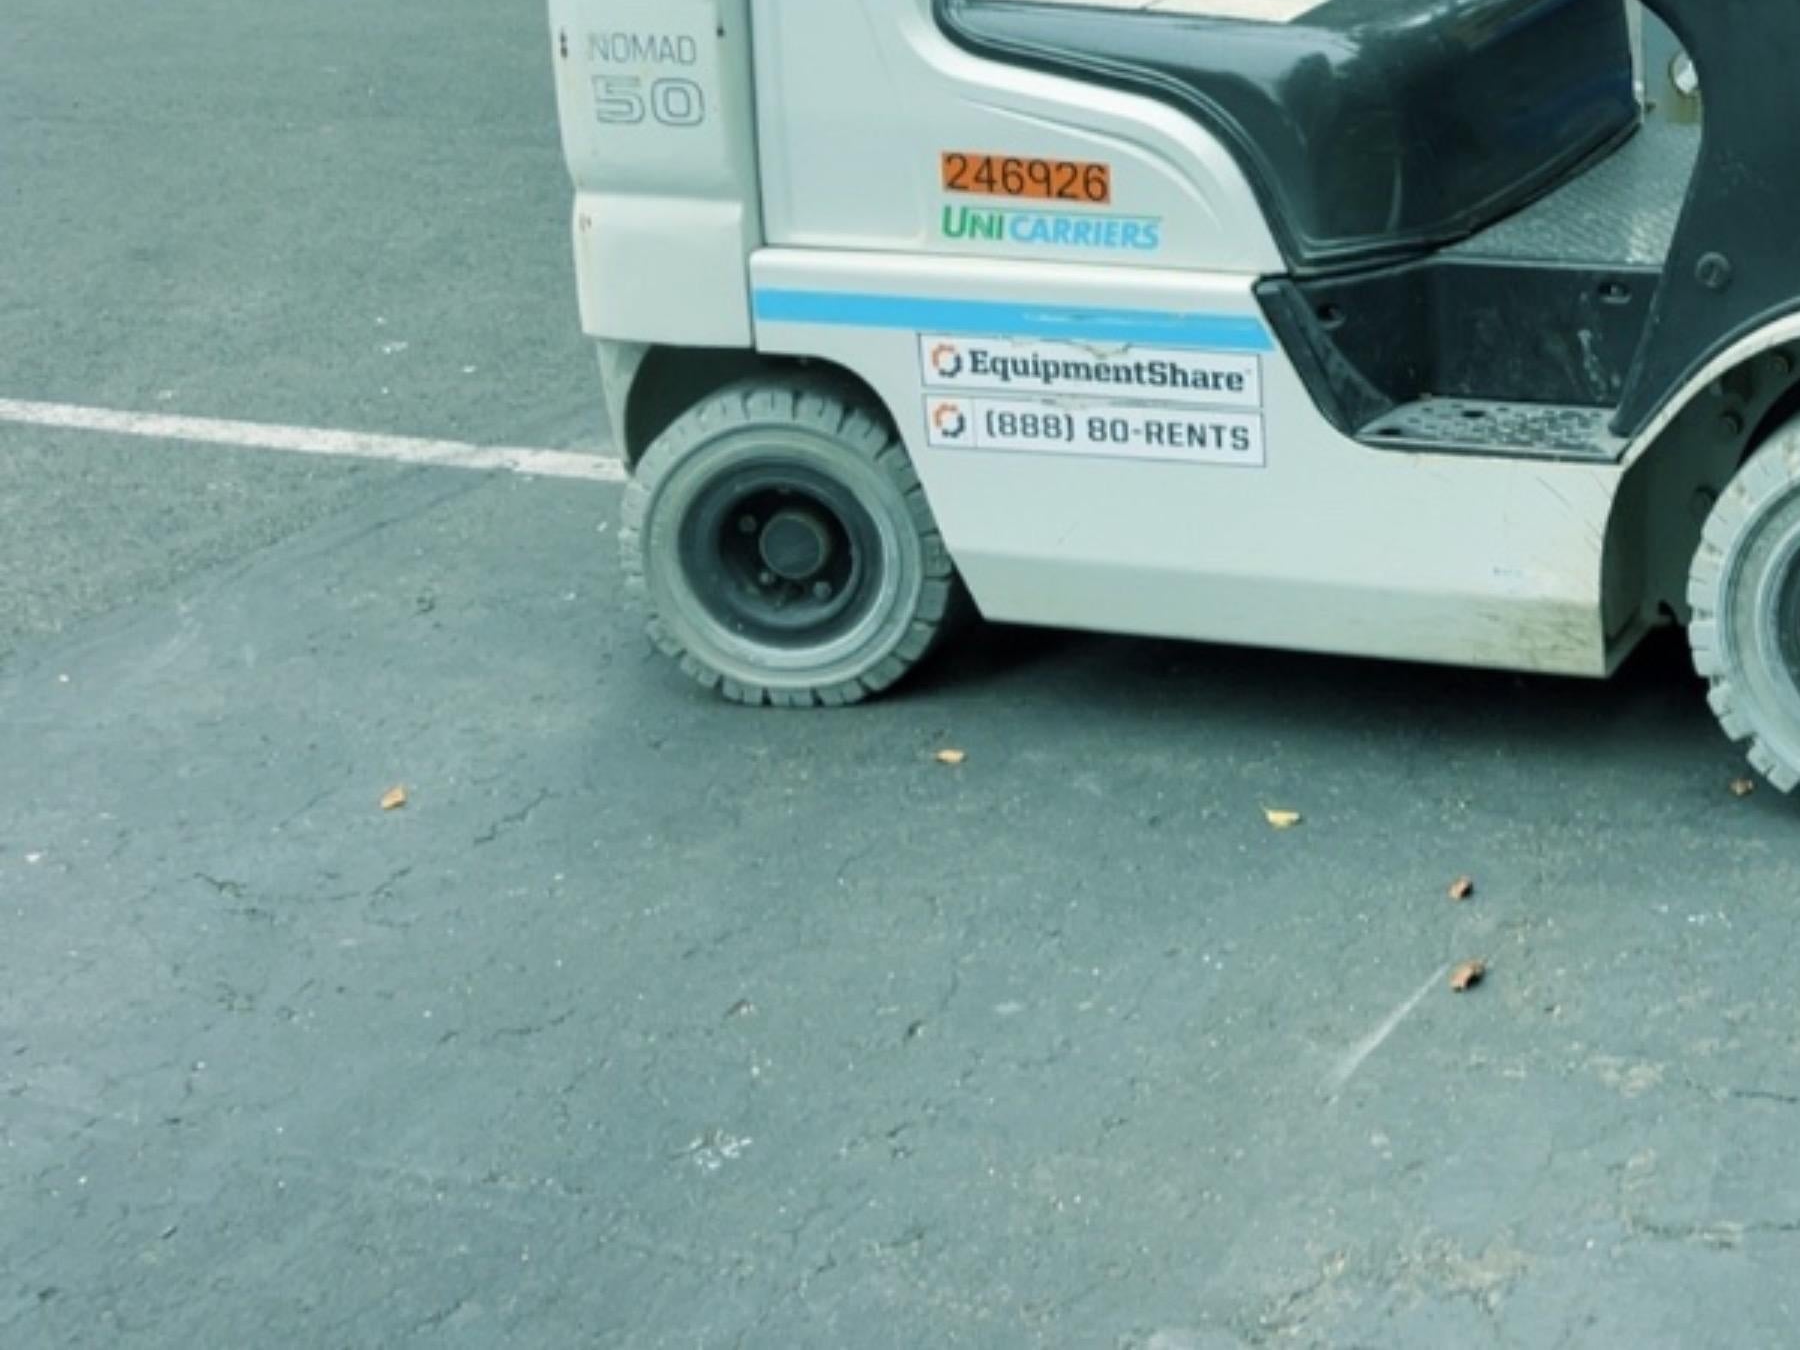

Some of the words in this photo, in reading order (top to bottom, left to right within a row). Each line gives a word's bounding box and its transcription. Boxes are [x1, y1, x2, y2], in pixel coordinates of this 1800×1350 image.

[587, 31, 697, 65] NOMAD
[591, 74, 706, 127] 50
[945, 152, 1109, 202] 246926
[968, 349, 1245, 392] EquipmentShare
[985, 409, 1075, 442] (888)
[1087, 416, 1250, 451] 80-RENTS
